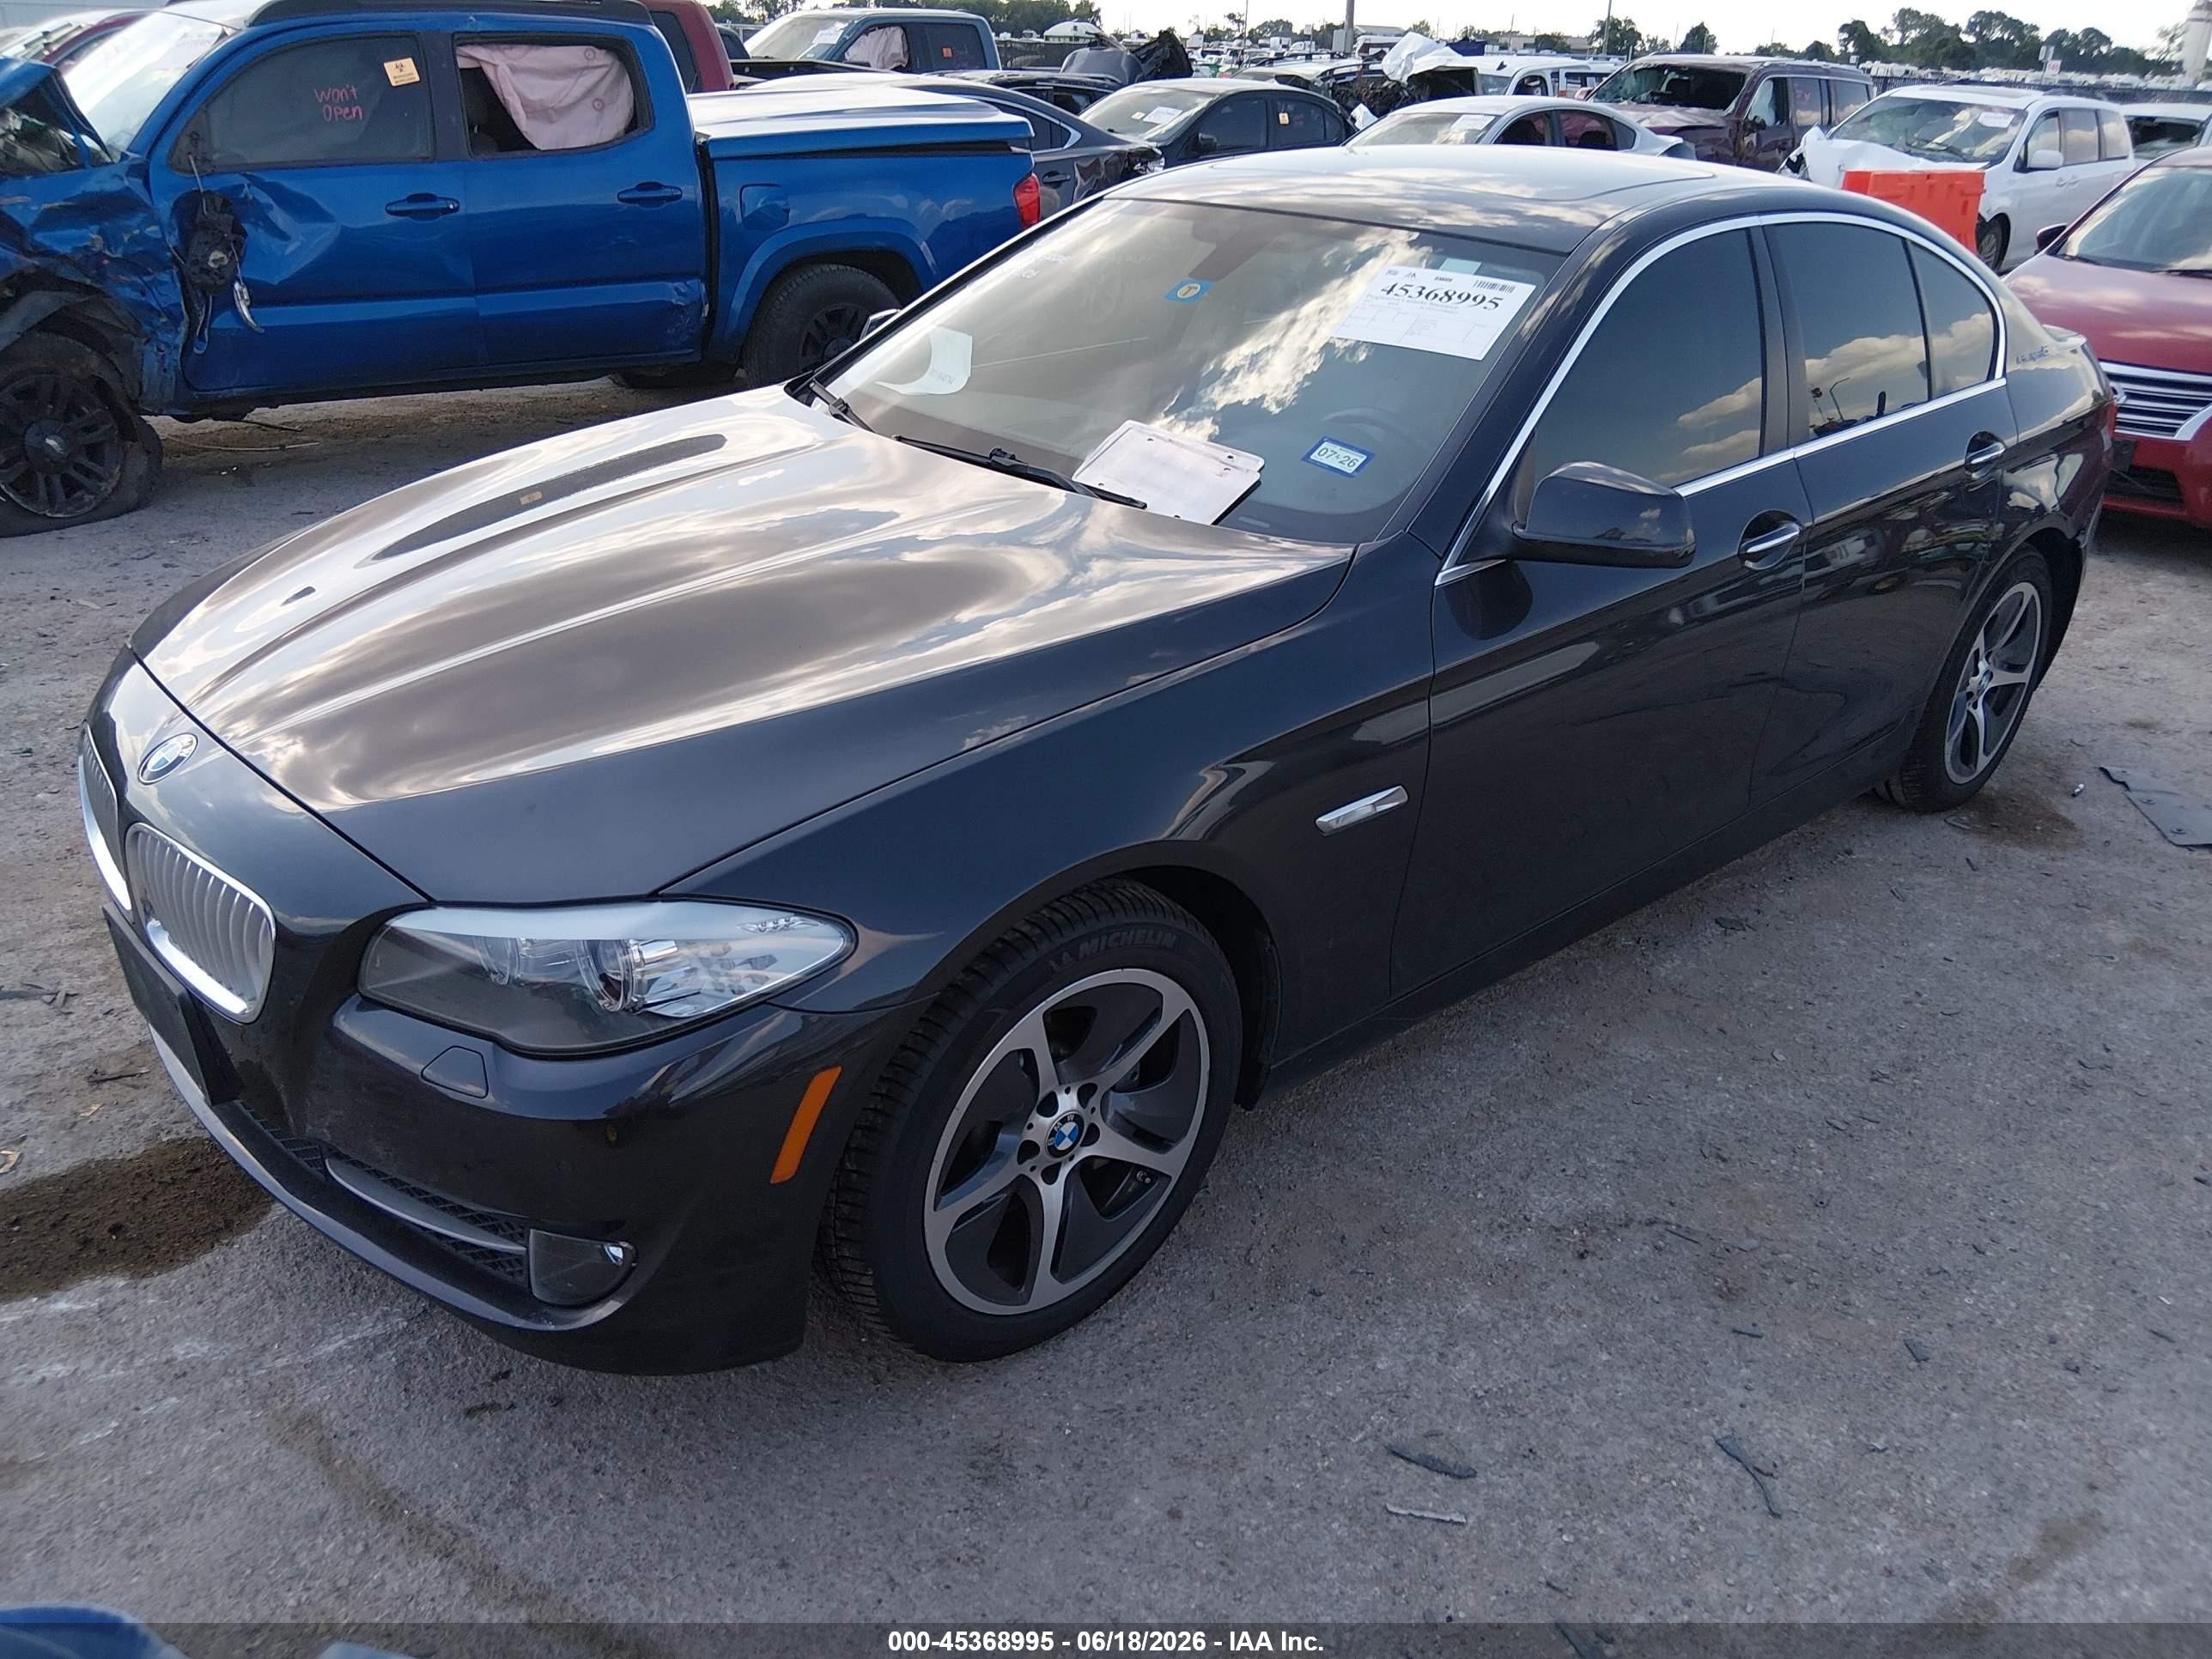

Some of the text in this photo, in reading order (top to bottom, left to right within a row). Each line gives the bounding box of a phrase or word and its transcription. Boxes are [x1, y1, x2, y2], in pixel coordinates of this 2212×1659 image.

[1382, 283, 1504, 310] 45368995
[1079, 928, 1177, 960] MICHELIN
[1048, 1114, 1074, 1146] BMW
